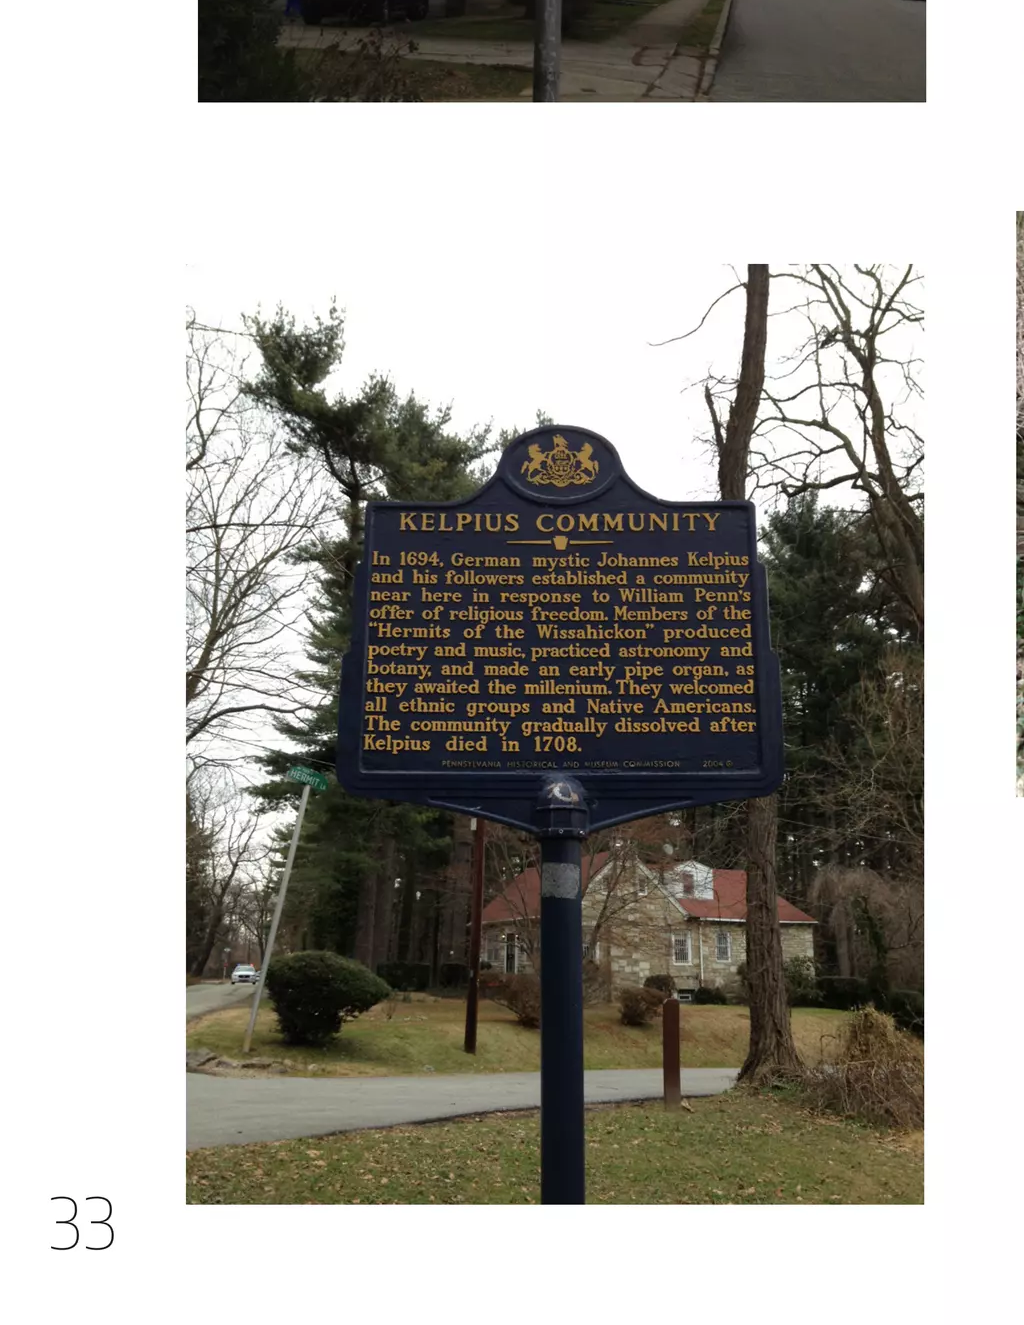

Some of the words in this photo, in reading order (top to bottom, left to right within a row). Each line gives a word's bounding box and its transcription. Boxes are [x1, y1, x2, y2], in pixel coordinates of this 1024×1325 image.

[400, 513, 519, 532] KELPIUS
[536, 513, 721, 532] COMMUNITY
[372, 550, 390, 564] In
[400, 551, 443, 567] 1694,
[451, 552, 520, 566] German
[533, 552, 588, 570] mystic
[597, 552, 678, 566] Johannes
[687, 551, 749, 569] Kelpius
[372, 569, 403, 583] and
[413, 569, 438, 583] his
[445, 569, 524, 583] followers
[532, 570, 627, 584] established
[636, 575, 645, 584] a
[653, 569, 749, 587] community
[371, 592, 410, 604] near
[422, 586, 462, 603] here
[473, 589, 489, 602] in
[500, 593, 581, 606] response
[592, 588, 609, 602] to
[620, 588, 683, 602] William
[695, 587, 751, 601] Penn's
[369, 604, 415, 618] offer
[422, 604, 444, 618] of
[449, 605, 523, 623] religious
[532, 606, 608, 620] freedom.
[614, 606, 687, 620] Members
[697, 605, 716, 619] of
[723, 605, 750, 619] the
[463, 624, 485, 638] of
[495, 624, 524, 638] the
[663, 623, 752, 641] produced
[368, 641, 427, 659] poetry
[434, 642, 465, 656] and
[474, 644, 524, 659] music,
[531, 643, 610, 661] practiced
[619, 643, 711, 661] astronomy
[720, 642, 752, 656] and
[367, 660, 432, 678] botany,
[441, 661, 473, 675] and
[484, 661, 528, 675] made
[539, 667, 560, 676] an
[569, 661, 615, 679] early
[624, 662, 664, 679] pipe
[672, 666, 729, 679] organ,
[736, 666, 754, 675] as
[367, 678, 408, 696] they
[415, 679, 479, 693] awaited
[488, 679, 516, 693] the
[524, 680, 613, 694] millenium.
[616, 680, 662, 698] They
[669, 679, 754, 693] welcomed
[365, 697, 387, 711] all
[399, 697, 455, 711] ethnic
[466, 704, 529, 717] groups
[543, 699, 575, 713] and
[588, 699, 643, 713] Native
[654, 699, 757, 713] Americans.
[365, 716, 401, 731] The
[410, 717, 510, 735] community
[521, 718, 607, 736] gradually
[615, 717, 700, 731] dissolved
[710, 717, 756, 731] after
[364, 733, 431, 754] Kelpius
[445, 737, 487, 751] died
[501, 738, 519, 751] in
[535, 737, 582, 751] 1708.
[442, 760, 501, 768] PENNSYLVANIA
[291, 770, 320, 787] HERMIT
